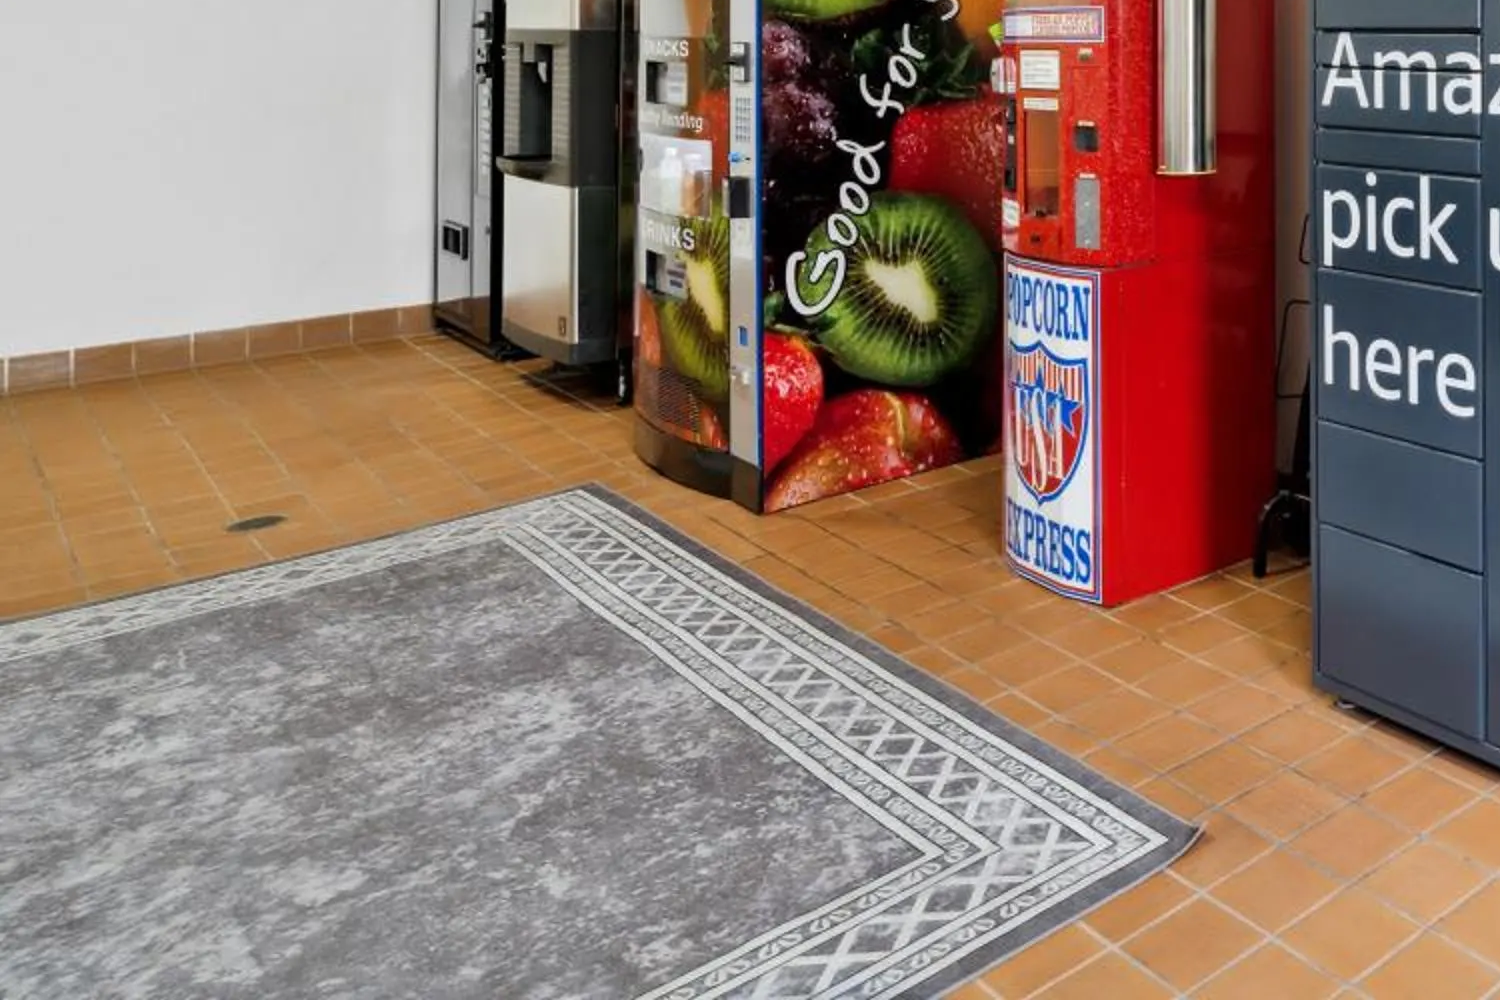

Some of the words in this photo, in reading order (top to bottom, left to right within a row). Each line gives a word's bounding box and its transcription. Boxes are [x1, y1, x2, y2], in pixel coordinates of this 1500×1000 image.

[785, 138, 886, 317] Good
[859, 22, 926, 119] for
[1321, 171, 1460, 270] pick
[1007, 271, 1090, 341] POPCORN
[1321, 302, 1477, 419] here
[1014, 385, 1064, 492] USA
[1007, 495, 1091, 584] EXPRESS
